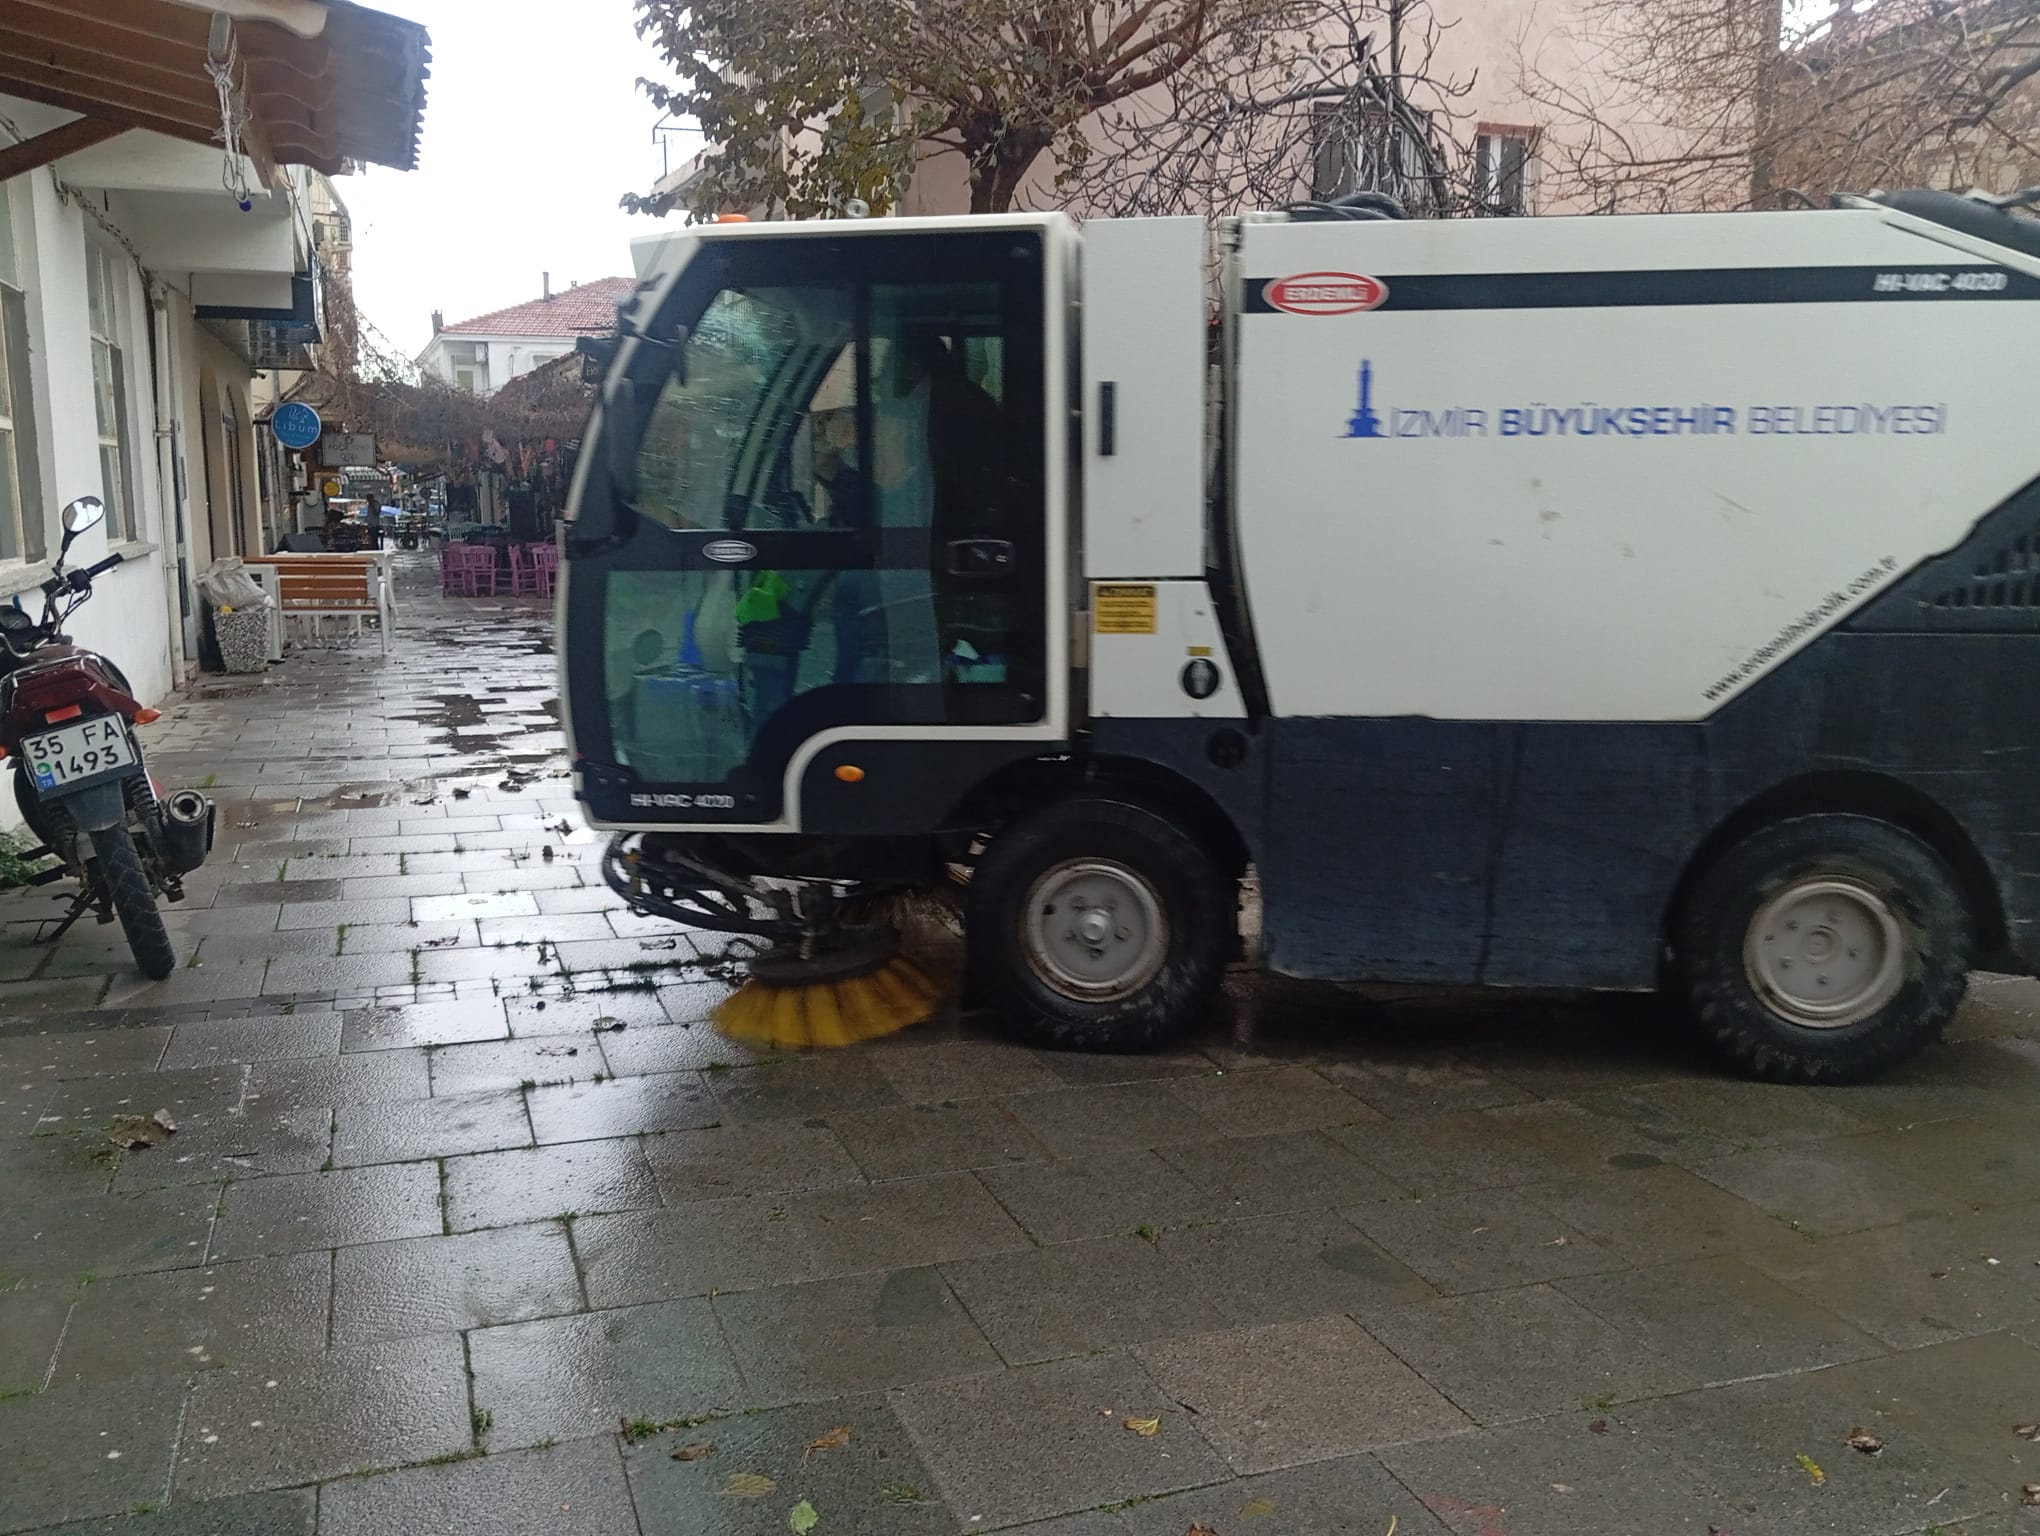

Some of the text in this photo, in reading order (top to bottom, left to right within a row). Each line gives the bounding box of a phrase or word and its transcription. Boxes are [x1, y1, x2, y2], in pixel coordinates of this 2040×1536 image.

[1389, 401, 1948, 440] İZMİR BÜYÜKŞEHİR BELEDİYESİ
[29, 720, 119, 760] 35 FA
[54, 744, 119, 780] 1493
[41, 778, 55, 788] TR
